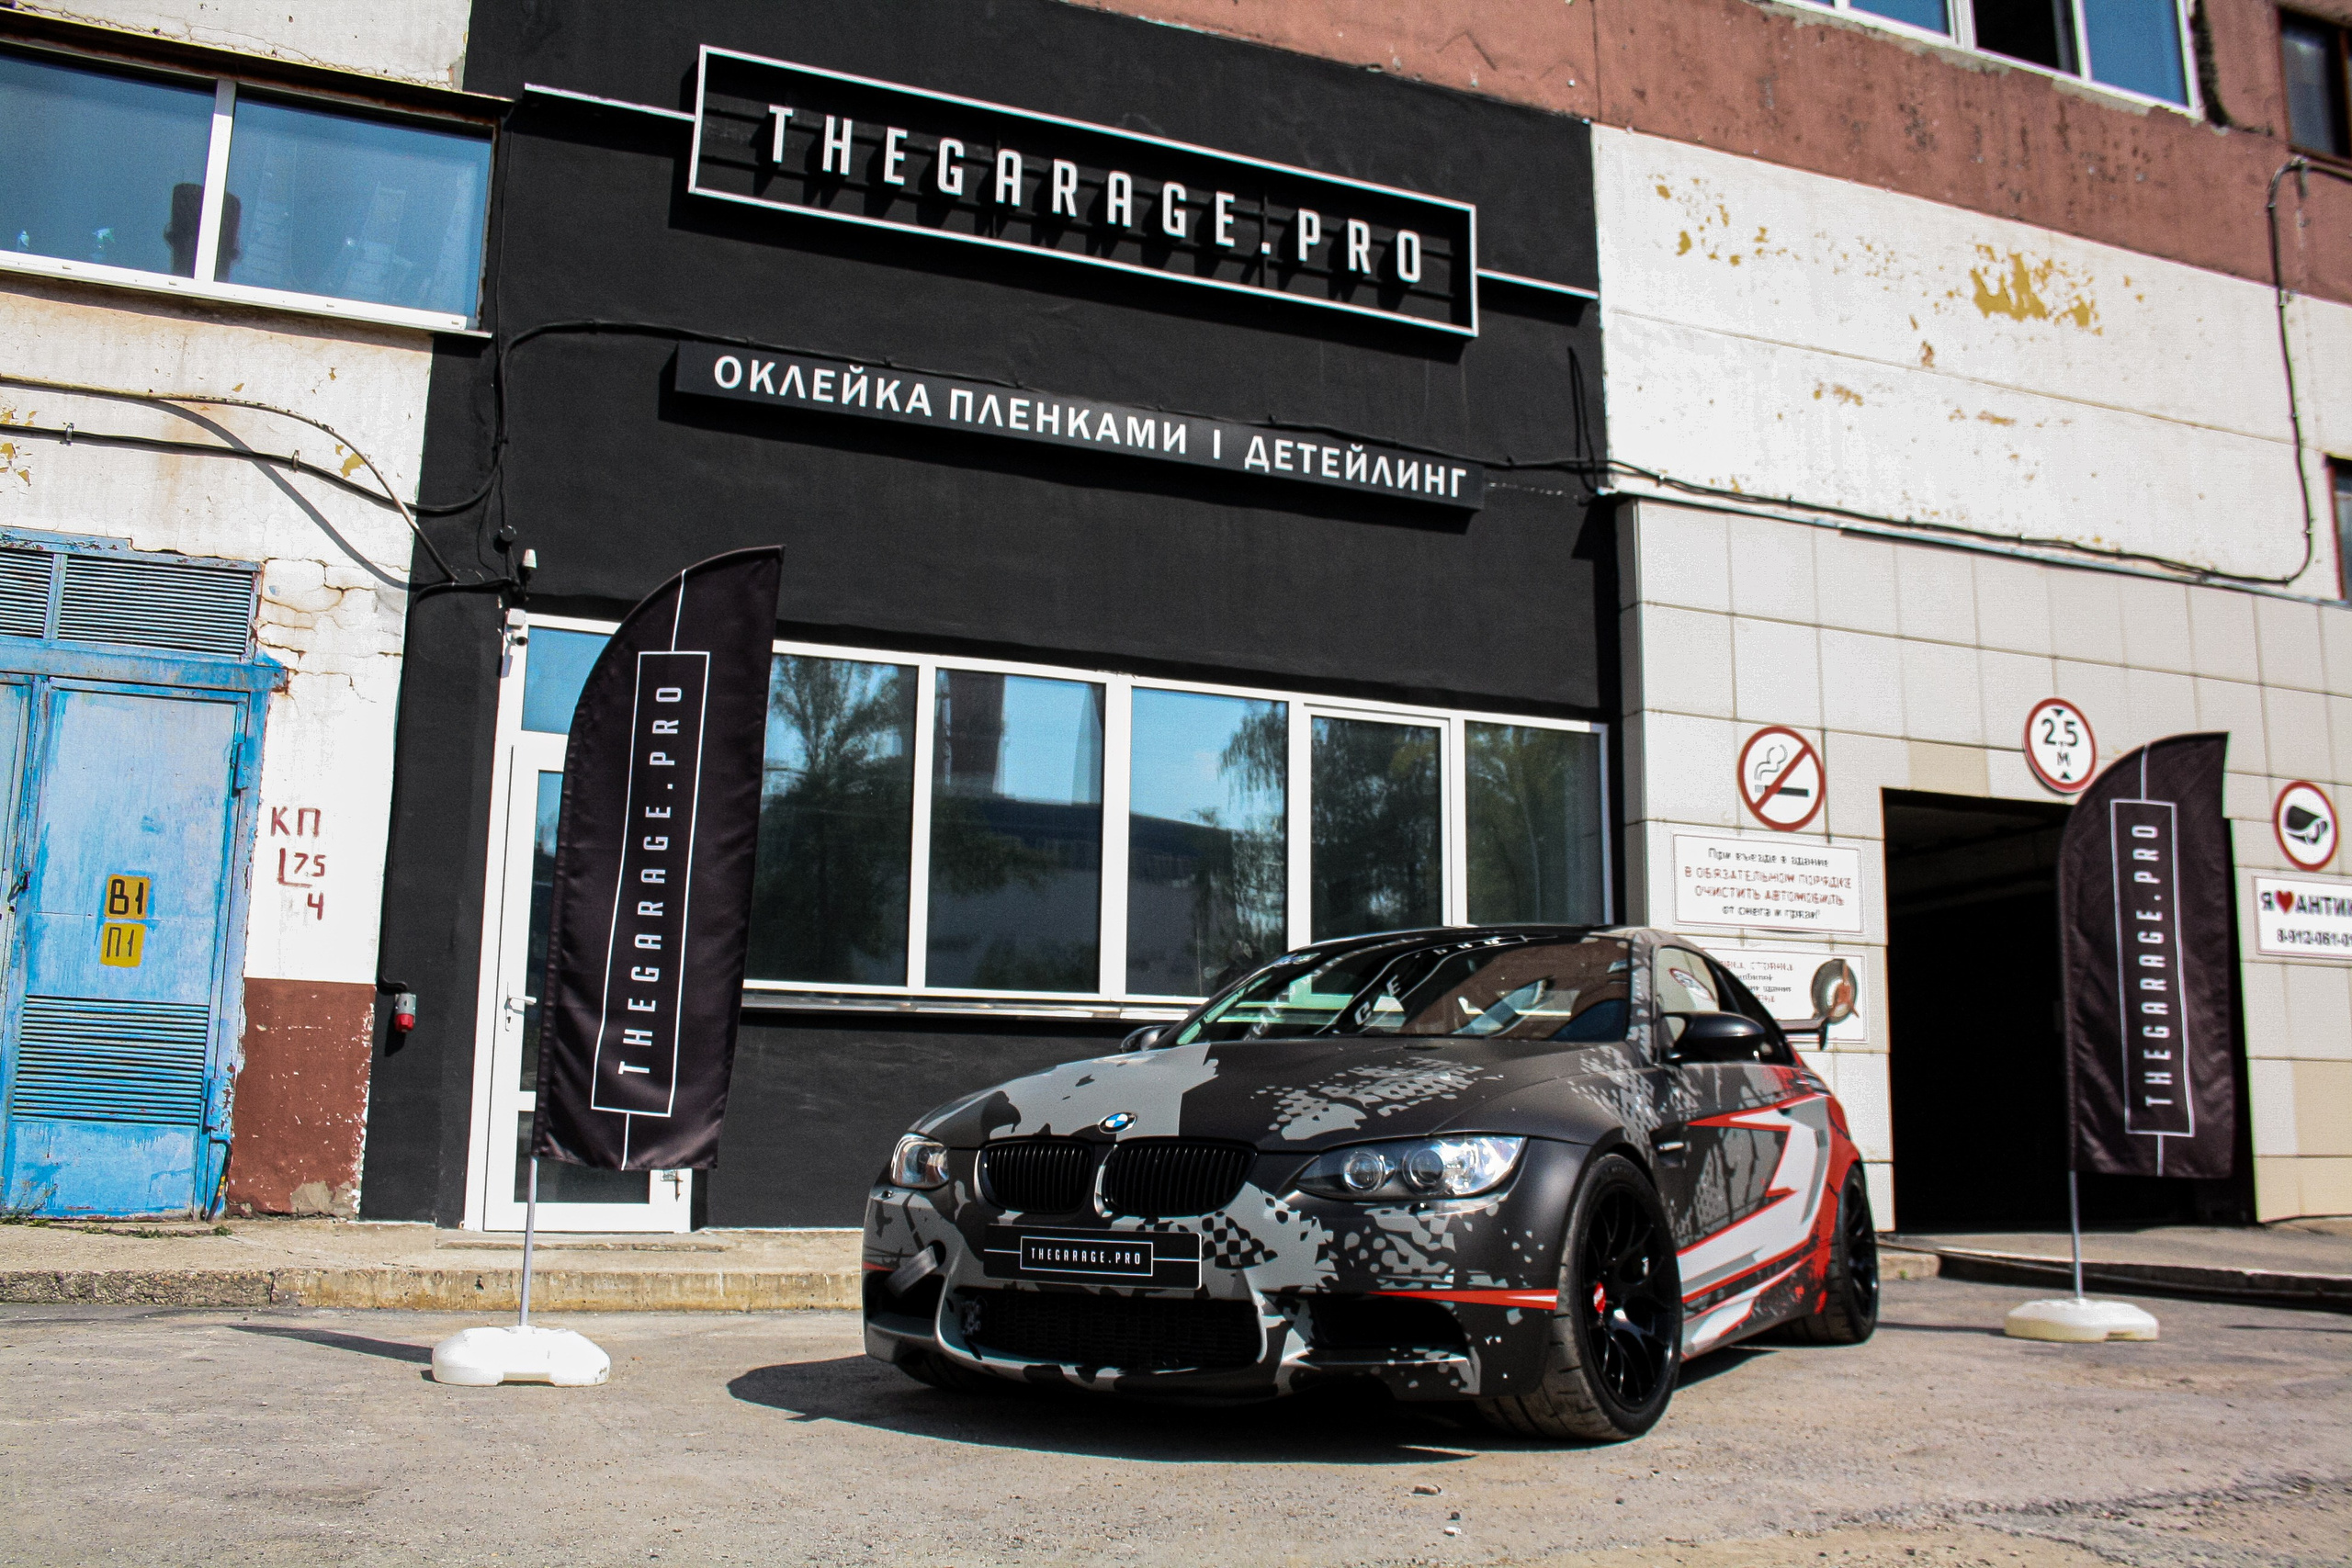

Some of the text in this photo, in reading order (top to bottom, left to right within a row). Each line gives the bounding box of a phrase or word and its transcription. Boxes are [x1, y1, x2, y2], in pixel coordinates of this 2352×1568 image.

[768, 104, 1422, 284] THEGARAGE.PRO
[714, 355, 932, 417] ОКЛЕЙКА
[949, 388, 1187, 455] ПЛЕНКАМИ
[1244, 434, 1467, 498] ДЕТЕЙЛИНГ
[617, 685, 682, 1076] THEGARAGE.PRO
[2132, 824, 2173, 1107] THEGARAGE.PRO
[1031, 1247, 1141, 1265] THEGARAGE.PRO
